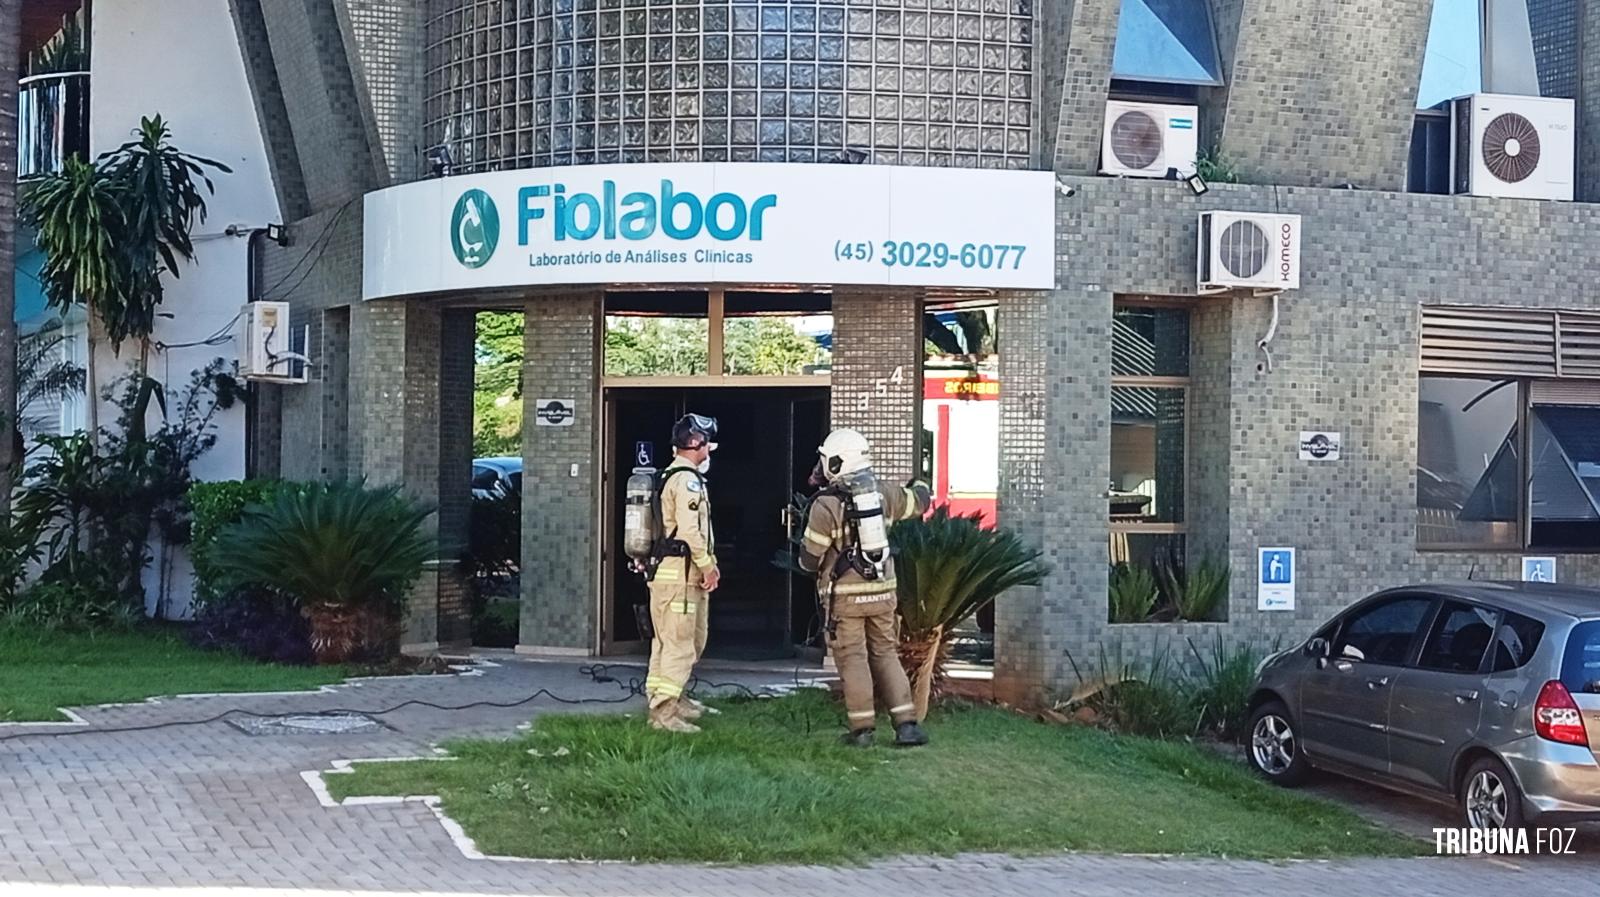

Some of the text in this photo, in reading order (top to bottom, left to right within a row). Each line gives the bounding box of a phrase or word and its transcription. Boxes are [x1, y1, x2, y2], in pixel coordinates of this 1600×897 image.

[518, 179, 777, 246] Fiolabor
[529, 251, 602, 267] Laboratório
[605, 252, 622, 264] de
[624, 249, 687, 264] Análises
[834, 240, 1026, 270] (45) 3029-6077
